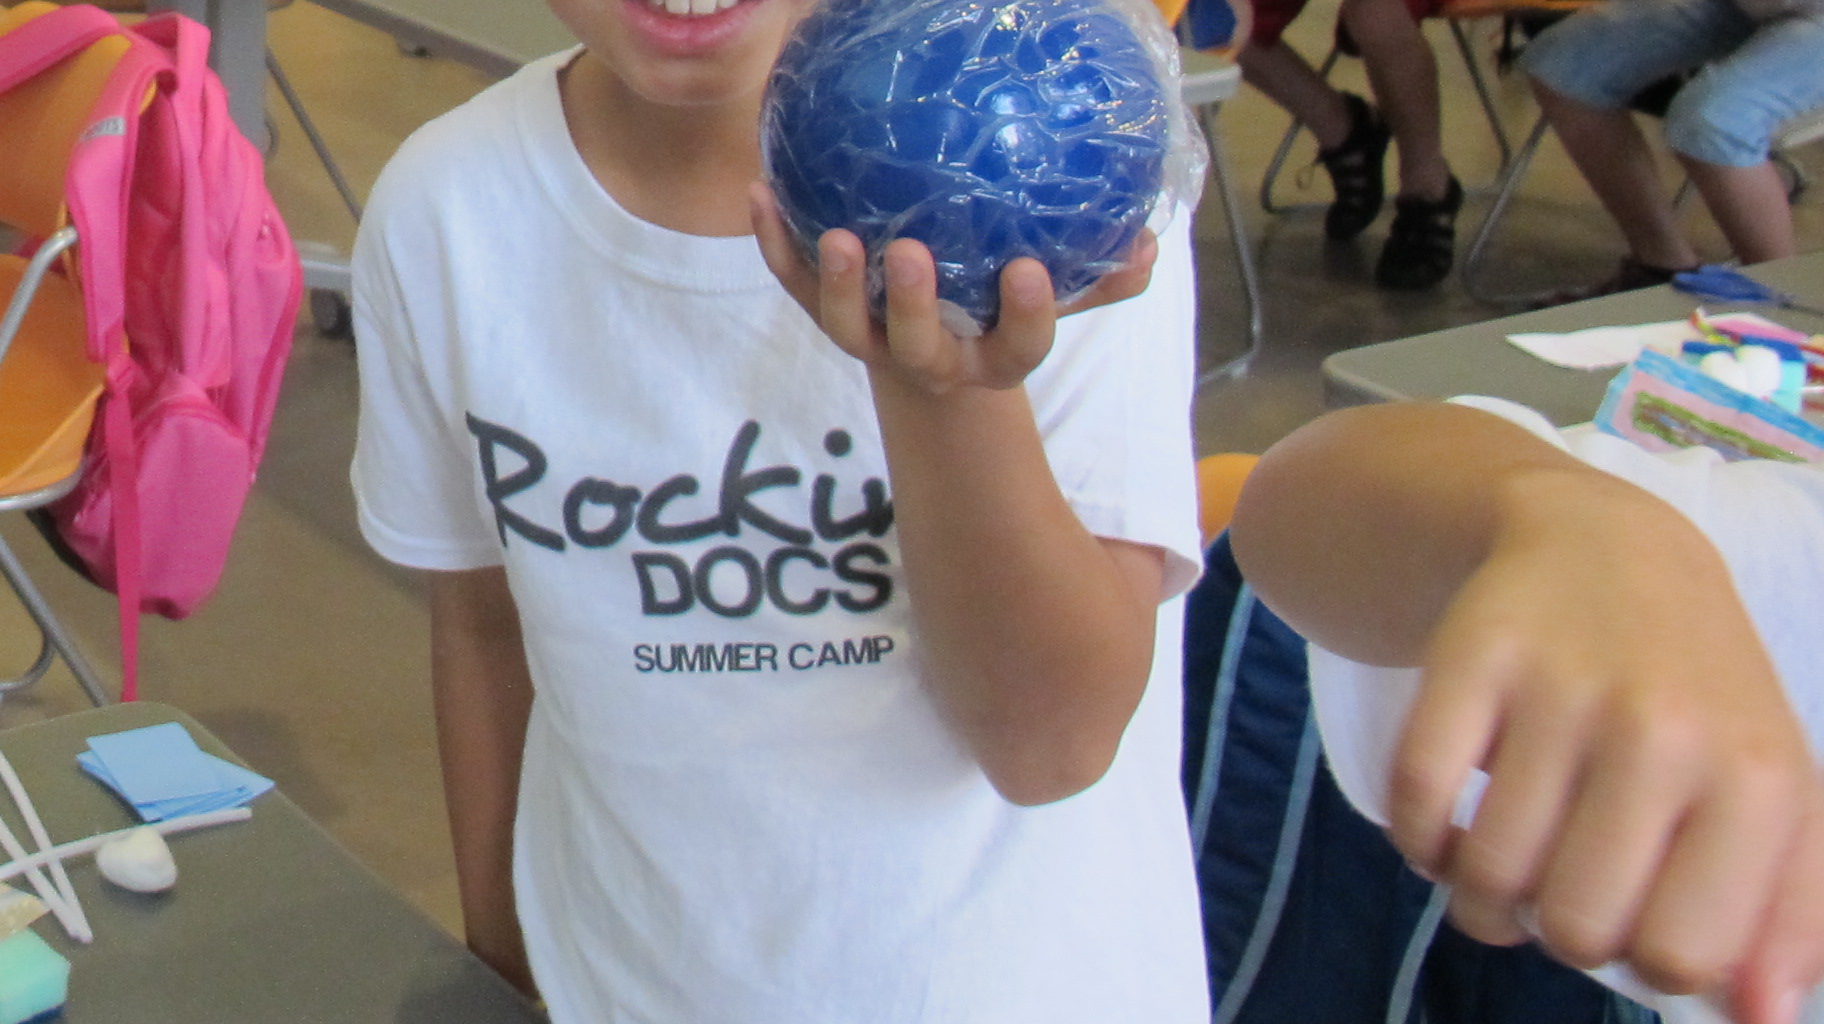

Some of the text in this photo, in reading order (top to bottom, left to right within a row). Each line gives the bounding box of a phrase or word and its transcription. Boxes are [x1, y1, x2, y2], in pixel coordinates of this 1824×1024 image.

[631, 542, 894, 618] DOCS
[633, 635, 896, 674] SUMMER CAMP
